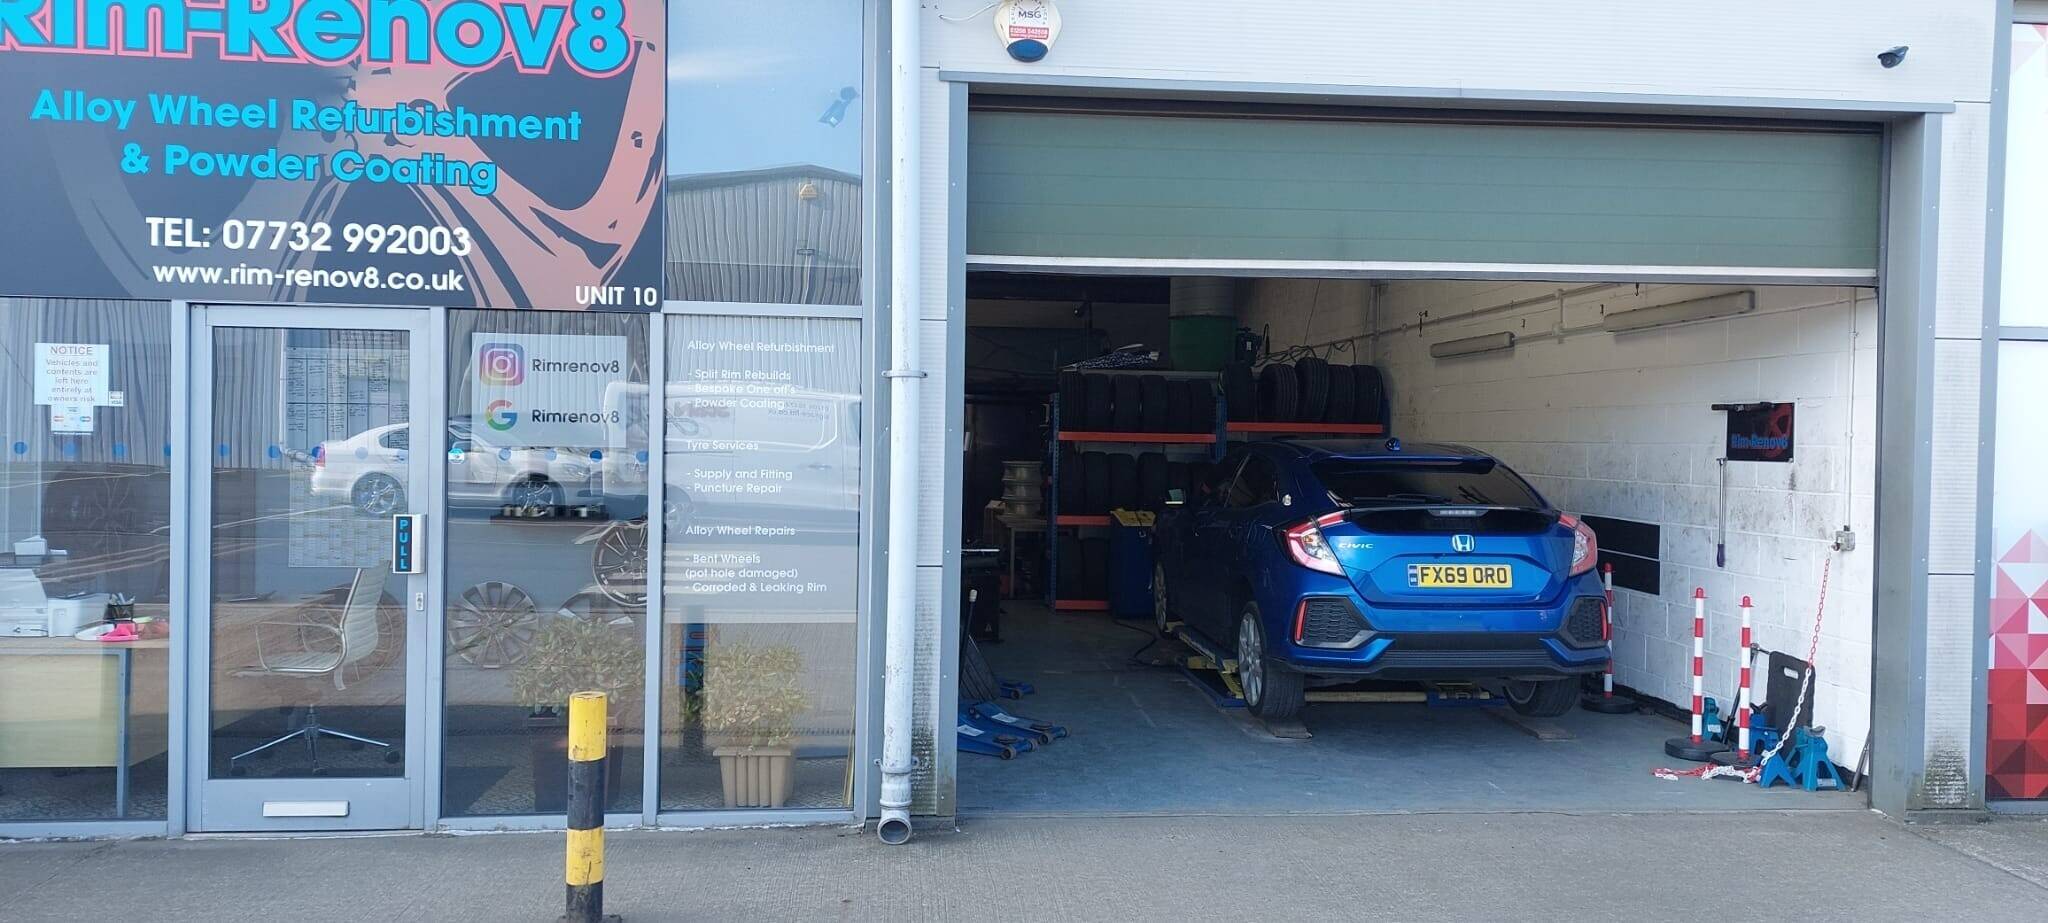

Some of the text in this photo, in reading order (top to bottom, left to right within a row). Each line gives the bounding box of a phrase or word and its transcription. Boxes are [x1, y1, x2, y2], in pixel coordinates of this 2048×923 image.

[30, 89, 582, 141] Alloy Wheel Refurbishment
[120, 142, 499, 196] & Powder Coating
[145, 216, 472, 257] TEL: 07732 992003
[152, 262, 465, 292] www.rim-renov8.co.uk
[575, 286, 657, 306] UNIT 10
[50, 346, 93, 355] NOTICE
[688, 340, 835, 353] Alloy Wheel Refurbishment
[532, 358, 620, 374] Rimrenov8
[694, 368, 718, 380] Split
[721, 370, 742, 380] Rim
[744, 370, 792, 380] Rebuilds
[52, 386, 82, 394] entirely
[694, 384, 744, 394] Bespoke
[746, 384, 770, 394] One
[694, 398, 737, 408] Powder
[740, 398, 785, 410] Coating
[532, 409, 620, 424] Rimrenov8
[686, 440, 759, 450] Tyre Services
[694, 468, 732, 480] Supply
[734, 468, 758, 478] and
[760, 470, 793, 480] Fitting
[694, 483, 743, 494] Puncture
[746, 484, 782, 494] Repair
[685, 525, 796, 537] Alloy Wheel Repairs
[399, 520, 409, 570] PULL
[692, 554, 718, 564] Bent
[720, 554, 761, 564] Wheels
[685, 568, 798, 580] (pot hole damaged)
[1420, 566, 1468, 584] FX69
[1472, 566, 1508, 584] ORO
[692, 582, 746, 592] Corroded
[750, 583, 758, 592] &
[760, 582, 804, 594] Leaking
[807, 582, 827, 592] Rim
